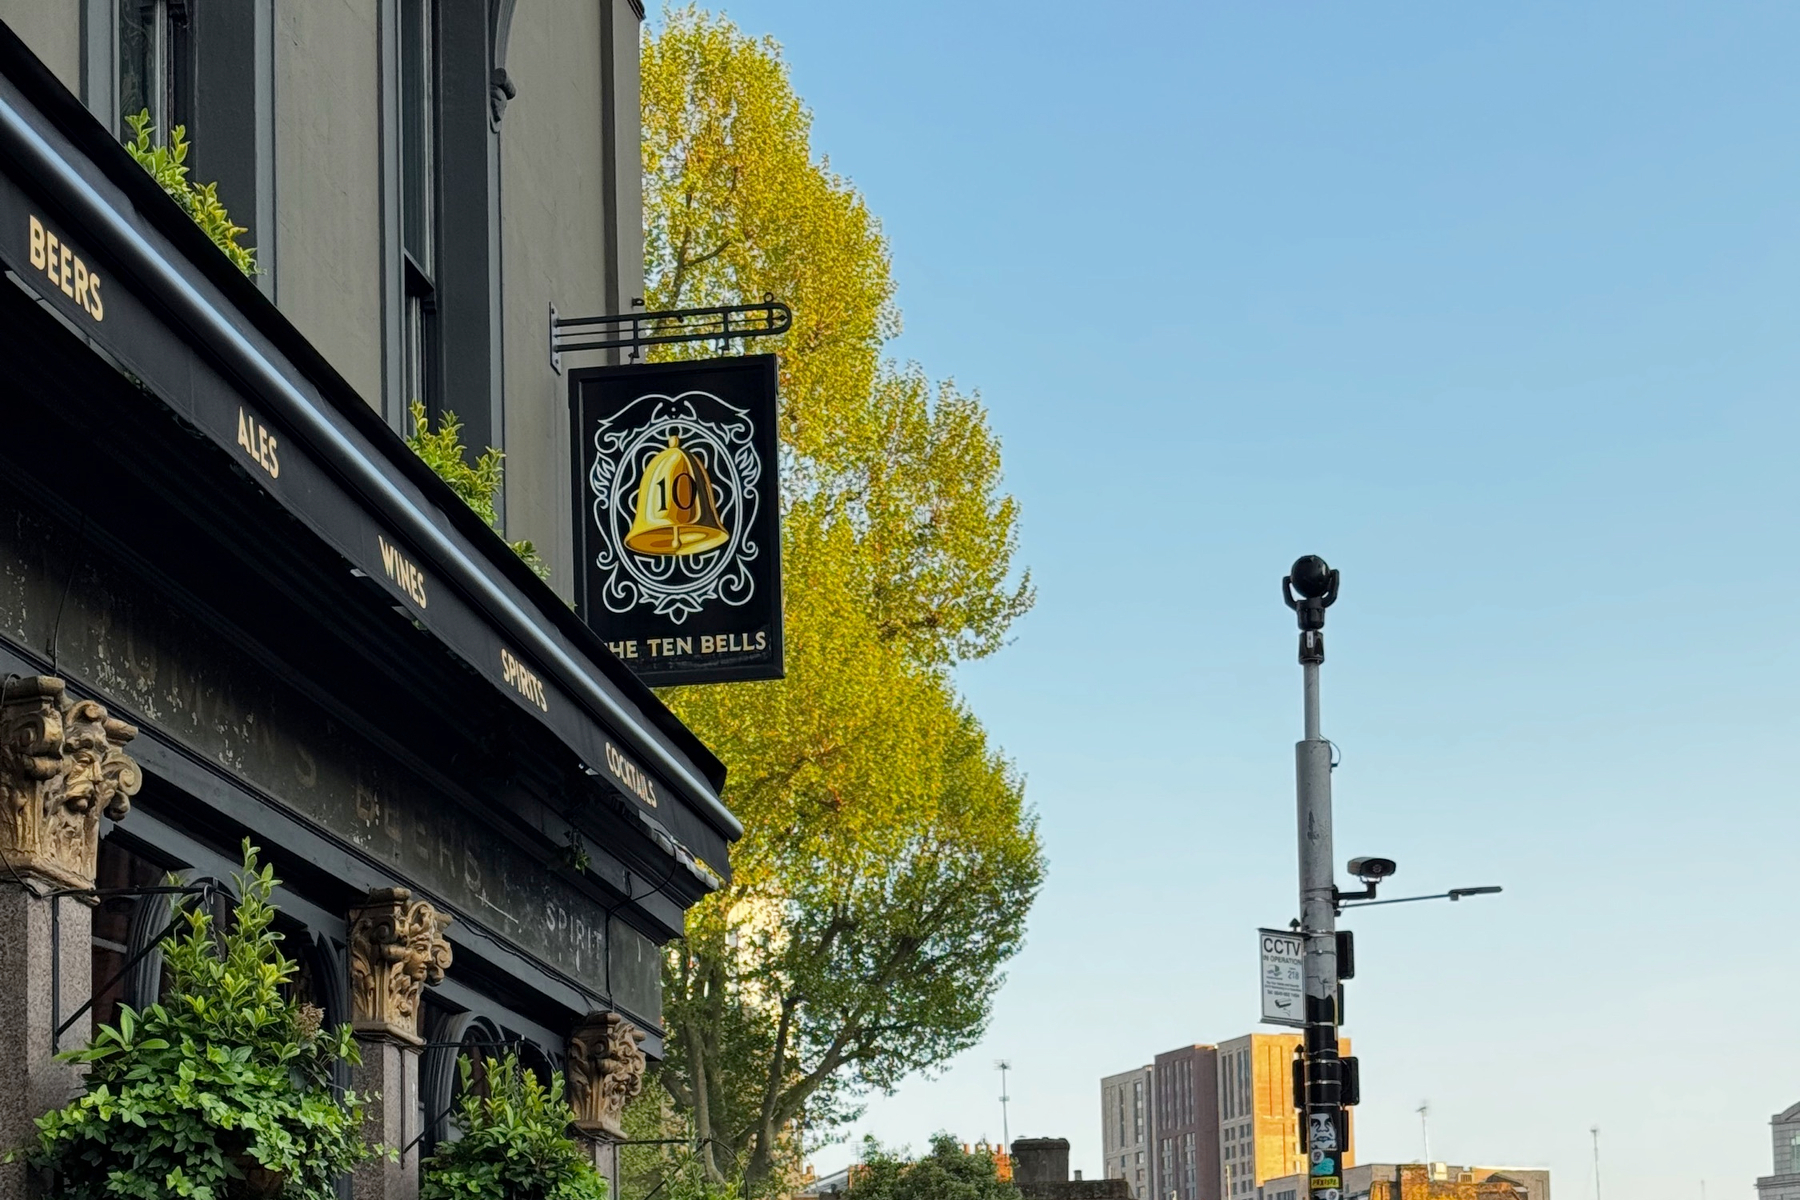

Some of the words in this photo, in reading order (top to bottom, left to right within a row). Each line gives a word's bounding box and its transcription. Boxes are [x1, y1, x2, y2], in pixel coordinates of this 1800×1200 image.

[30, 214, 104, 322] BEERS
[237, 405, 279, 479] ALES
[656, 472, 697, 512] 10
[378, 534, 427, 609] WINES
[604, 640, 639, 659] HE
[647, 637, 693, 657] TEN
[700, 631, 767, 654] BELLS
[501, 648, 548, 713] SPIRITS
[605, 742, 658, 808] COCKTAILS
[1264, 938, 1301, 956] CCTV
